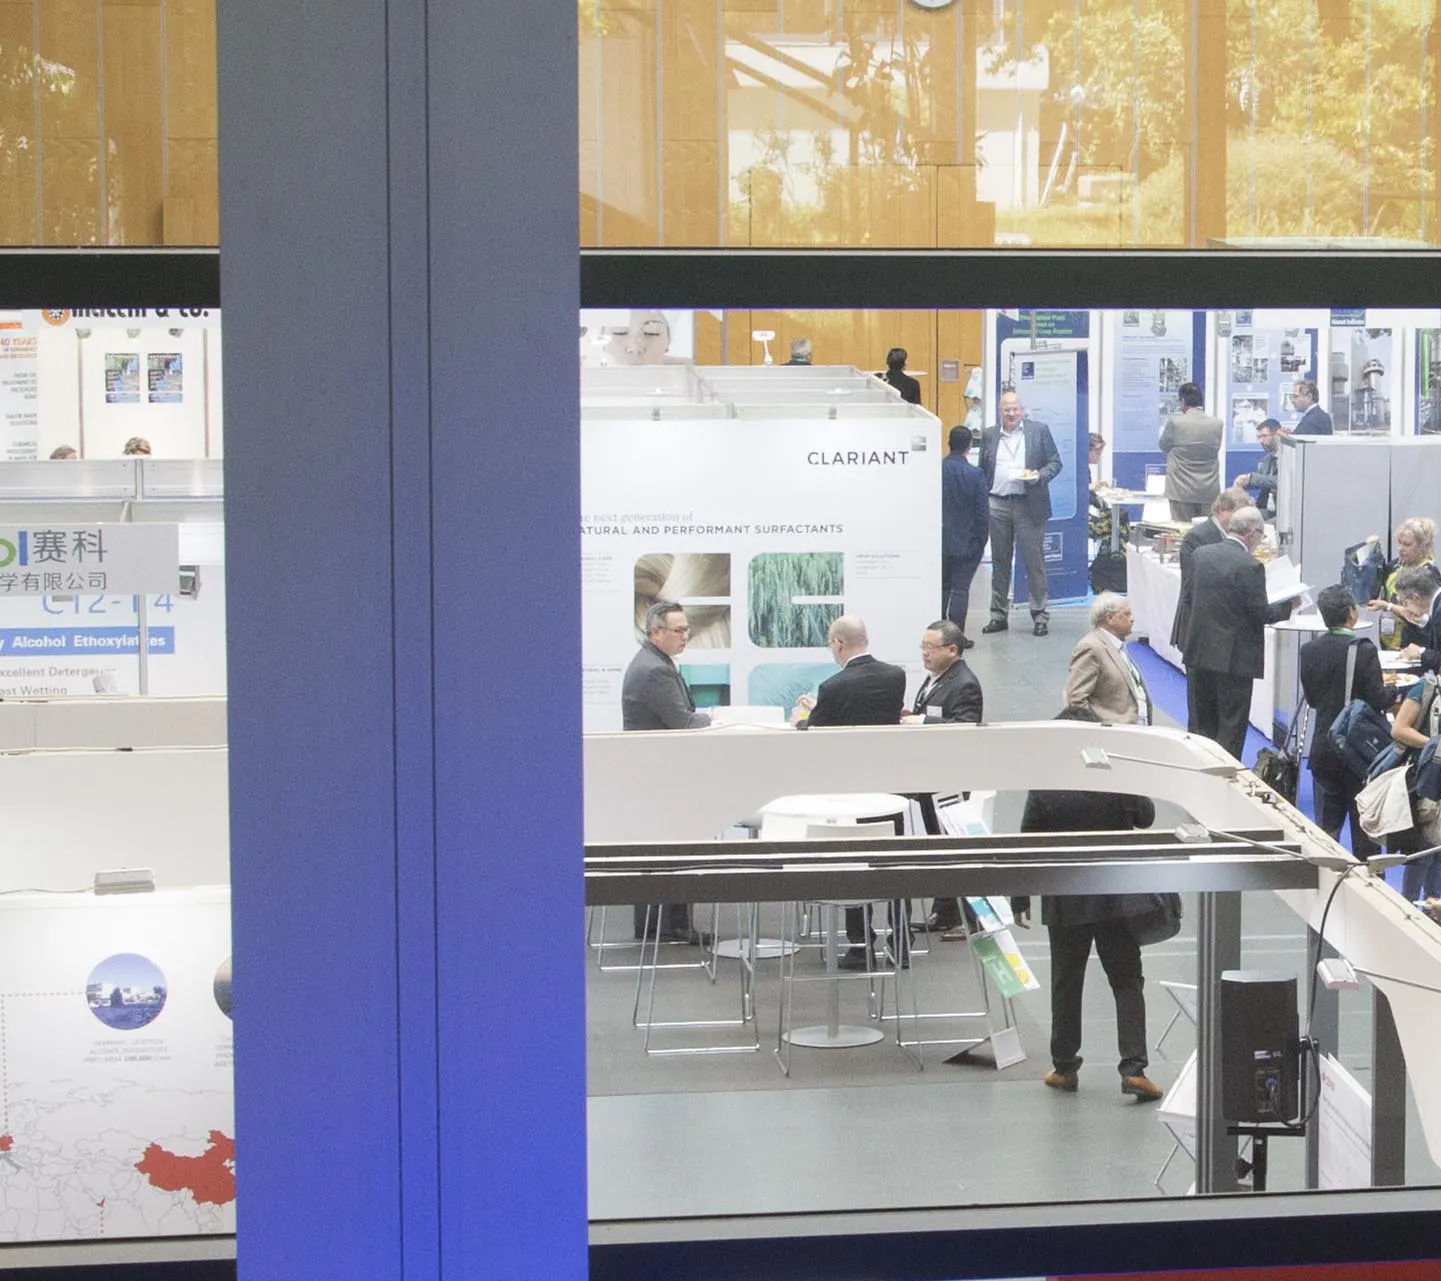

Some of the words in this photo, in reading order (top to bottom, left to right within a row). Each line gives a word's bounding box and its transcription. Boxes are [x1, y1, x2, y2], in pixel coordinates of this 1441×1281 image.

[808, 451, 909, 465] CLARIANT
[593, 511, 617, 521] next
[620, 511, 678, 523] generation
[681, 510, 693, 521] of
[580, 525, 628, 536] ATURAL
[633, 525, 660, 535] AND
[664, 524, 750, 535] PERFORMANT
[755, 523, 843, 534] SURFACTANTS
[33, 529, 107, 564] 赛科
[13, 635, 66, 649] Alcohol
[20, 685, 68, 697] Wetting
